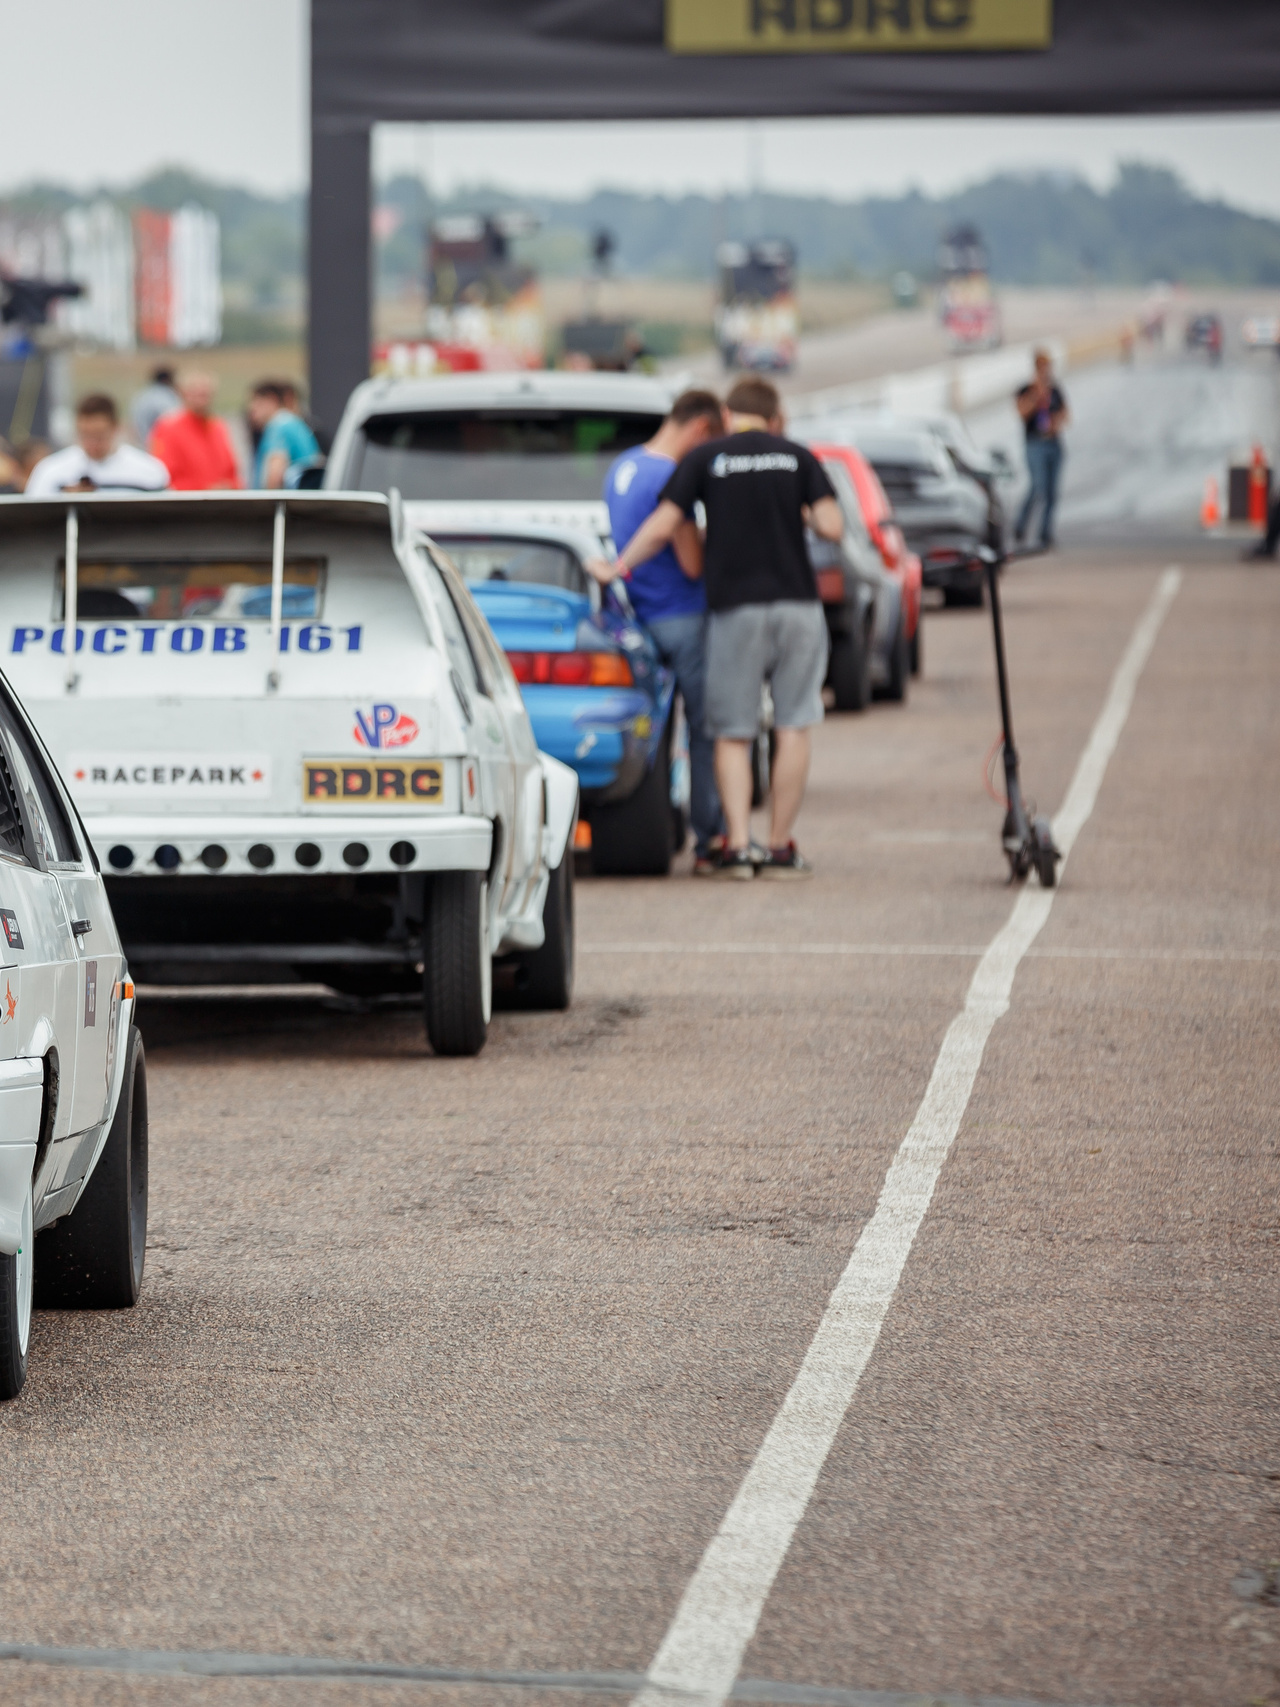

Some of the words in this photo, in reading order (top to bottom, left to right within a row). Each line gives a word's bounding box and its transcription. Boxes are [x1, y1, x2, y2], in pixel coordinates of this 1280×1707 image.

[11, 626, 248, 652] РОСТОВ
[355, 703, 396, 748] VP
[92, 766, 246, 785] RACEPARK
[307, 768, 441, 797] RDRC
